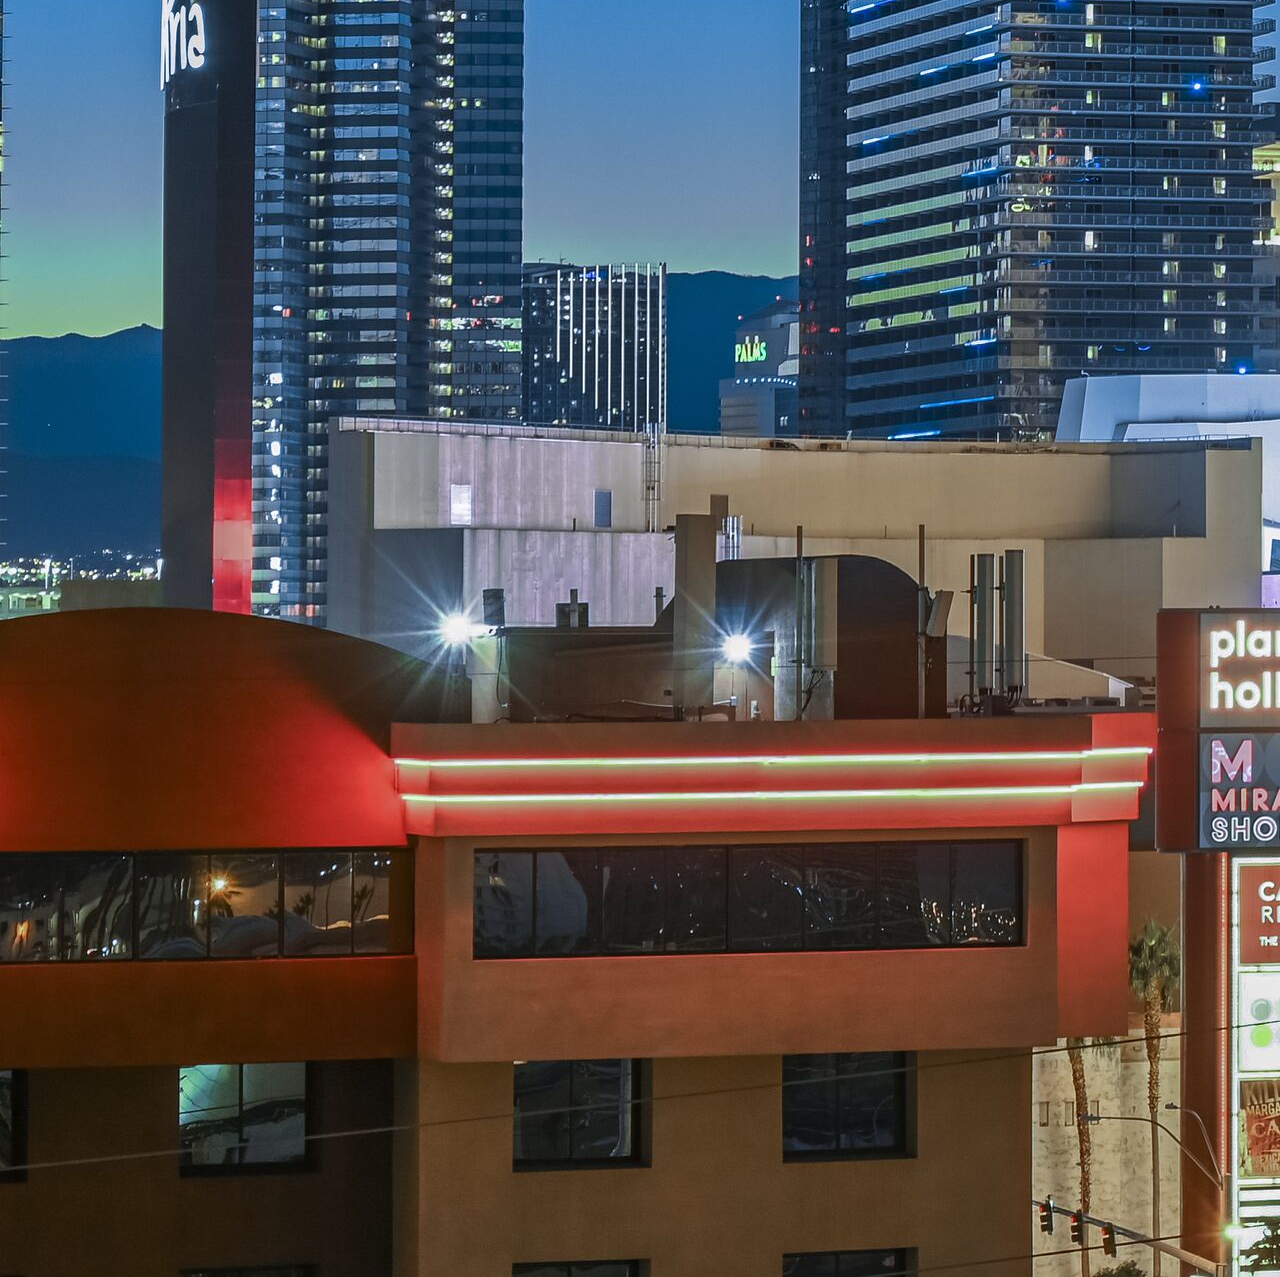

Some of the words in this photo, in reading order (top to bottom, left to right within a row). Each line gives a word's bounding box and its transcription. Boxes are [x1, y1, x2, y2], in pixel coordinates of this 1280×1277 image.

[735, 336, 767, 363] PALMS
[1211, 739, 1253, 784] M
[1259, 935, 1279, 947] THE
